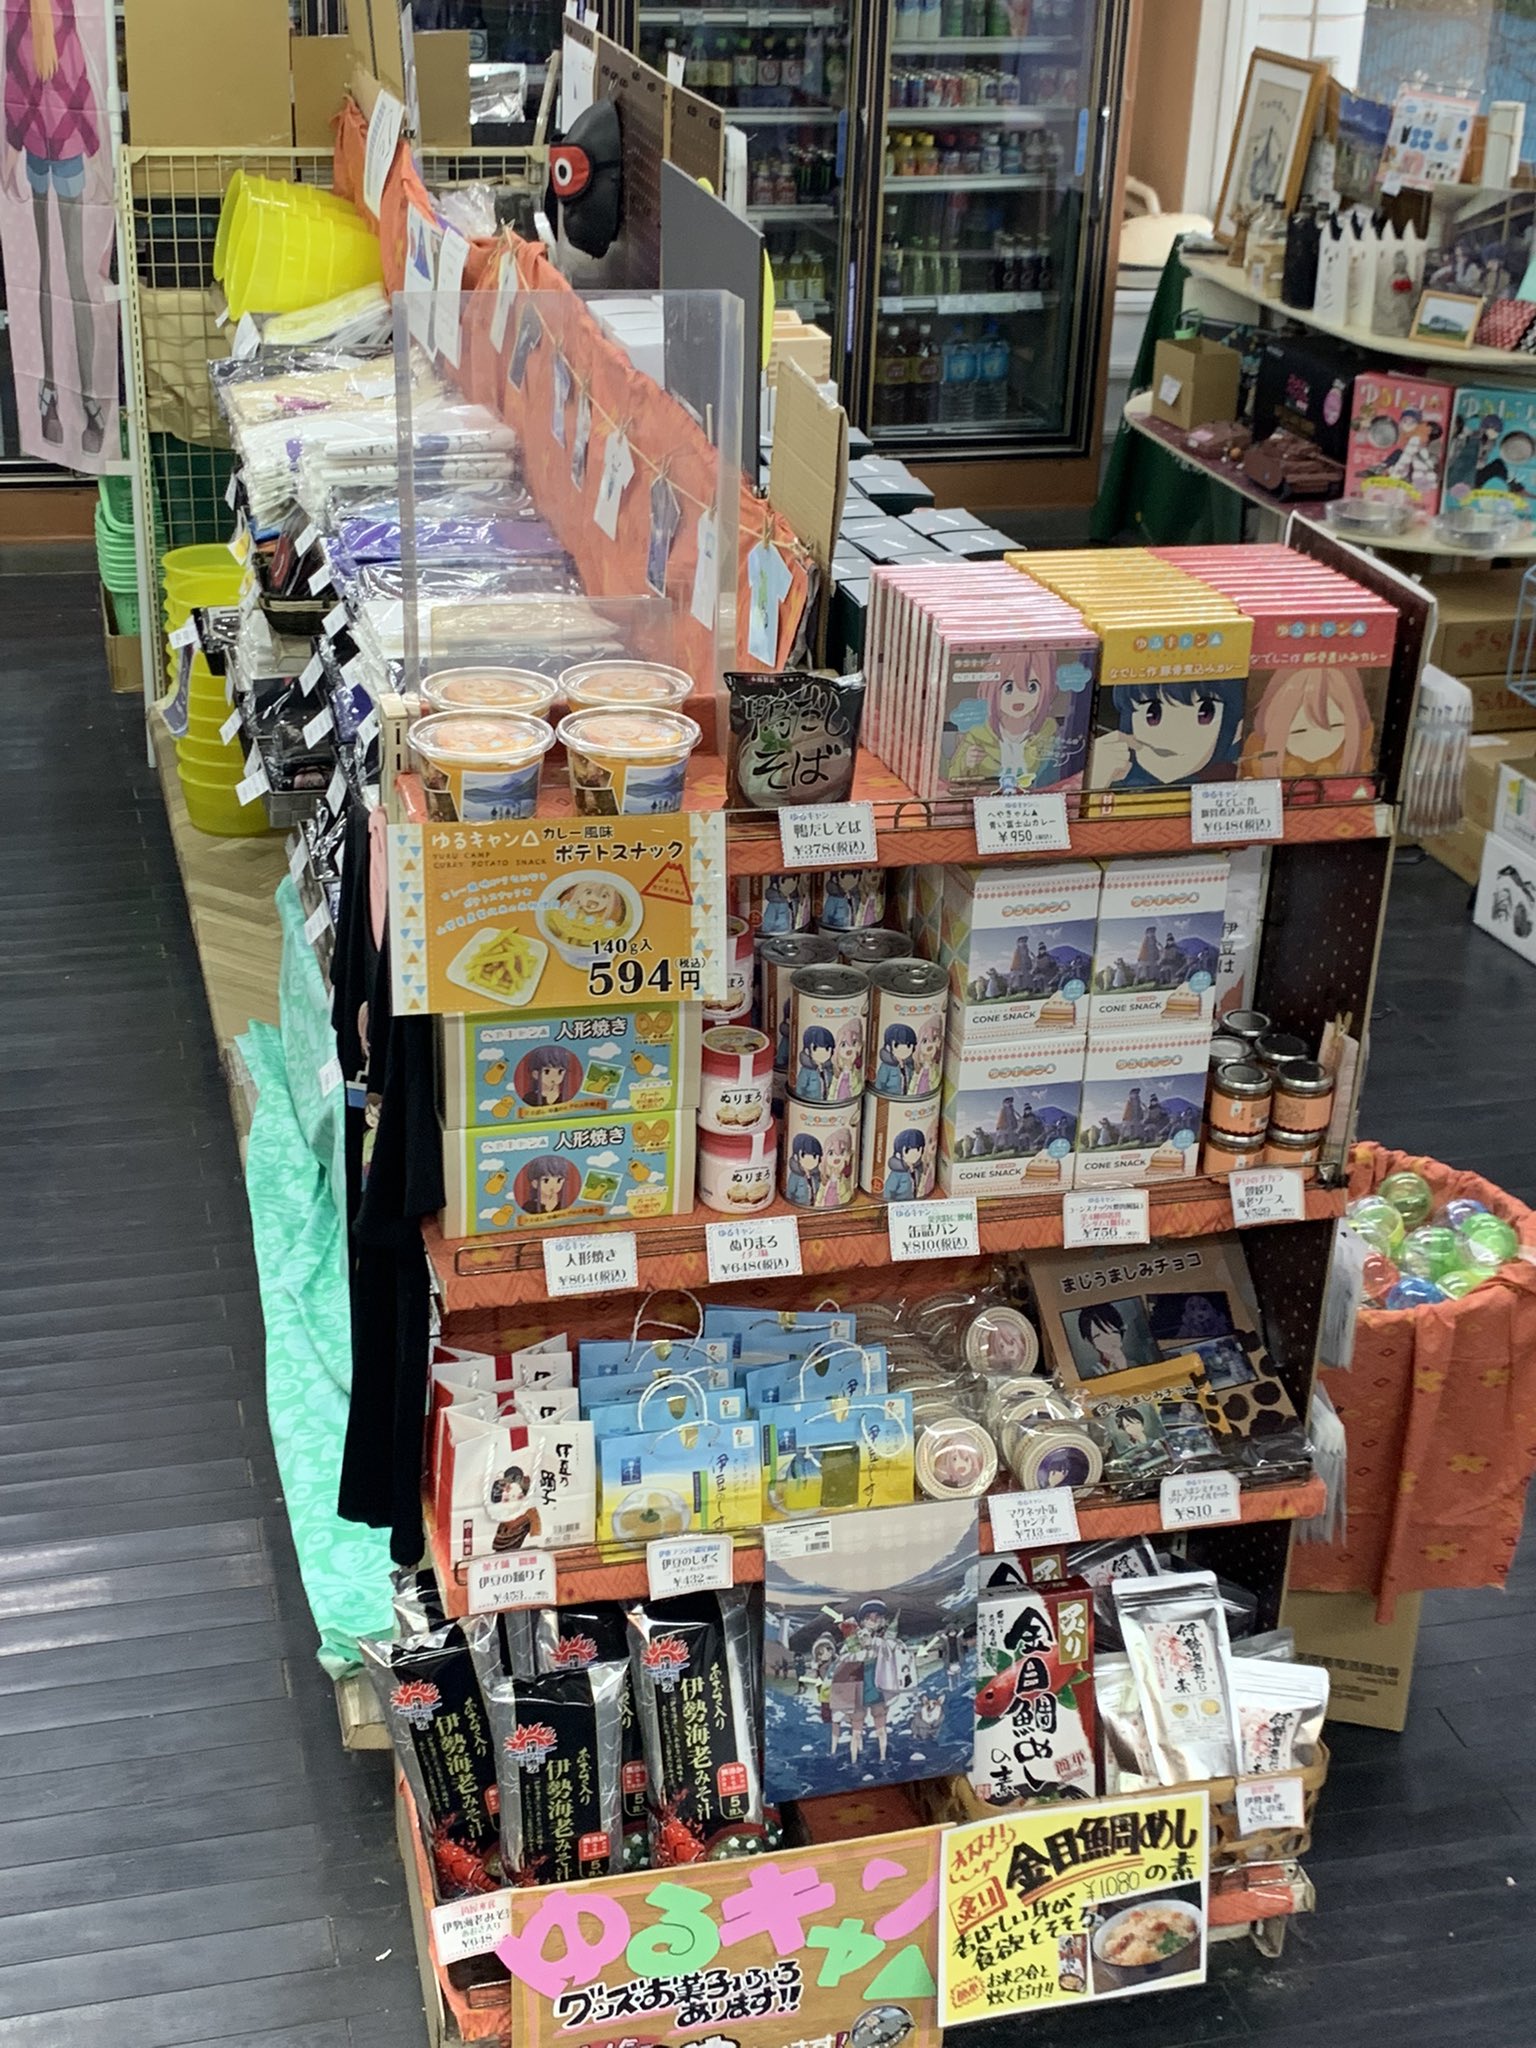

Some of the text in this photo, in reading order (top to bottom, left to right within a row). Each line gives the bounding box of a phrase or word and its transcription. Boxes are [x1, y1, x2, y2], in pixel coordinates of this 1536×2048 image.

[752, 744, 841, 790] そば
[543, 825, 614, 840] カレー風味
[794, 820, 862, 838] 鴨だしそば
[989, 819, 1056, 829] 青い富士山カレー
[555, 839, 685, 863] ポテトスナック
[471, 858, 509, 868] POTATO
[516, 857, 548, 866] SNACK
[592, 939, 653, 955] 140g入
[588, 958, 673, 997] 594
[1099, 1001, 1162, 1013] CONE SNACK
[972, 1010, 1036, 1024] CONE SNACK
[555, 1016, 628, 1041] 人形焼き
[720, 1093, 763, 1104] ぬりまろ
[553, 1126, 626, 1151] 人形焼き
[1084, 1158, 1146, 1171] CONE SNACK
[731, 1171, 771, 1184] ぬりまろ
[959, 1167, 1022, 1181] CONE SNACK
[908, 1223, 958, 1238] 缶詰パン
[1083, 1226, 1118, 1238] ¥756
[729, 1234, 779, 1251] ぬりまろ
[566, 1248, 616, 1267] 人形焼き
[1061, 1252, 1202, 1293] まじうましみチョコ
[1175, 1504, 1212, 1519] ¥810
[662, 1552, 719, 1570] 伊豆のしずく
[1059, 1601, 1088, 1660] 炙り
[1003, 1606, 1059, 1792] 金目鯛めし
[680, 1675, 714, 1820] 伊勢海老みそ汁
[434, 1712, 484, 1839] 伊勢海老みそ汁
[730, 1794, 740, 1807] 5
[545, 1757, 575, 1882] 伊勢海老みそ汁
[1006, 1808, 1198, 1900] 金目鯛めし
[591, 1860, 601, 1871] 5
[1144, 1851, 1197, 1881] の素
[973, 1906, 1096, 1972] 食欲をそそる
[987, 1964, 1051, 1989] お米2合と
[676, 1985, 802, 2028] あります!!
